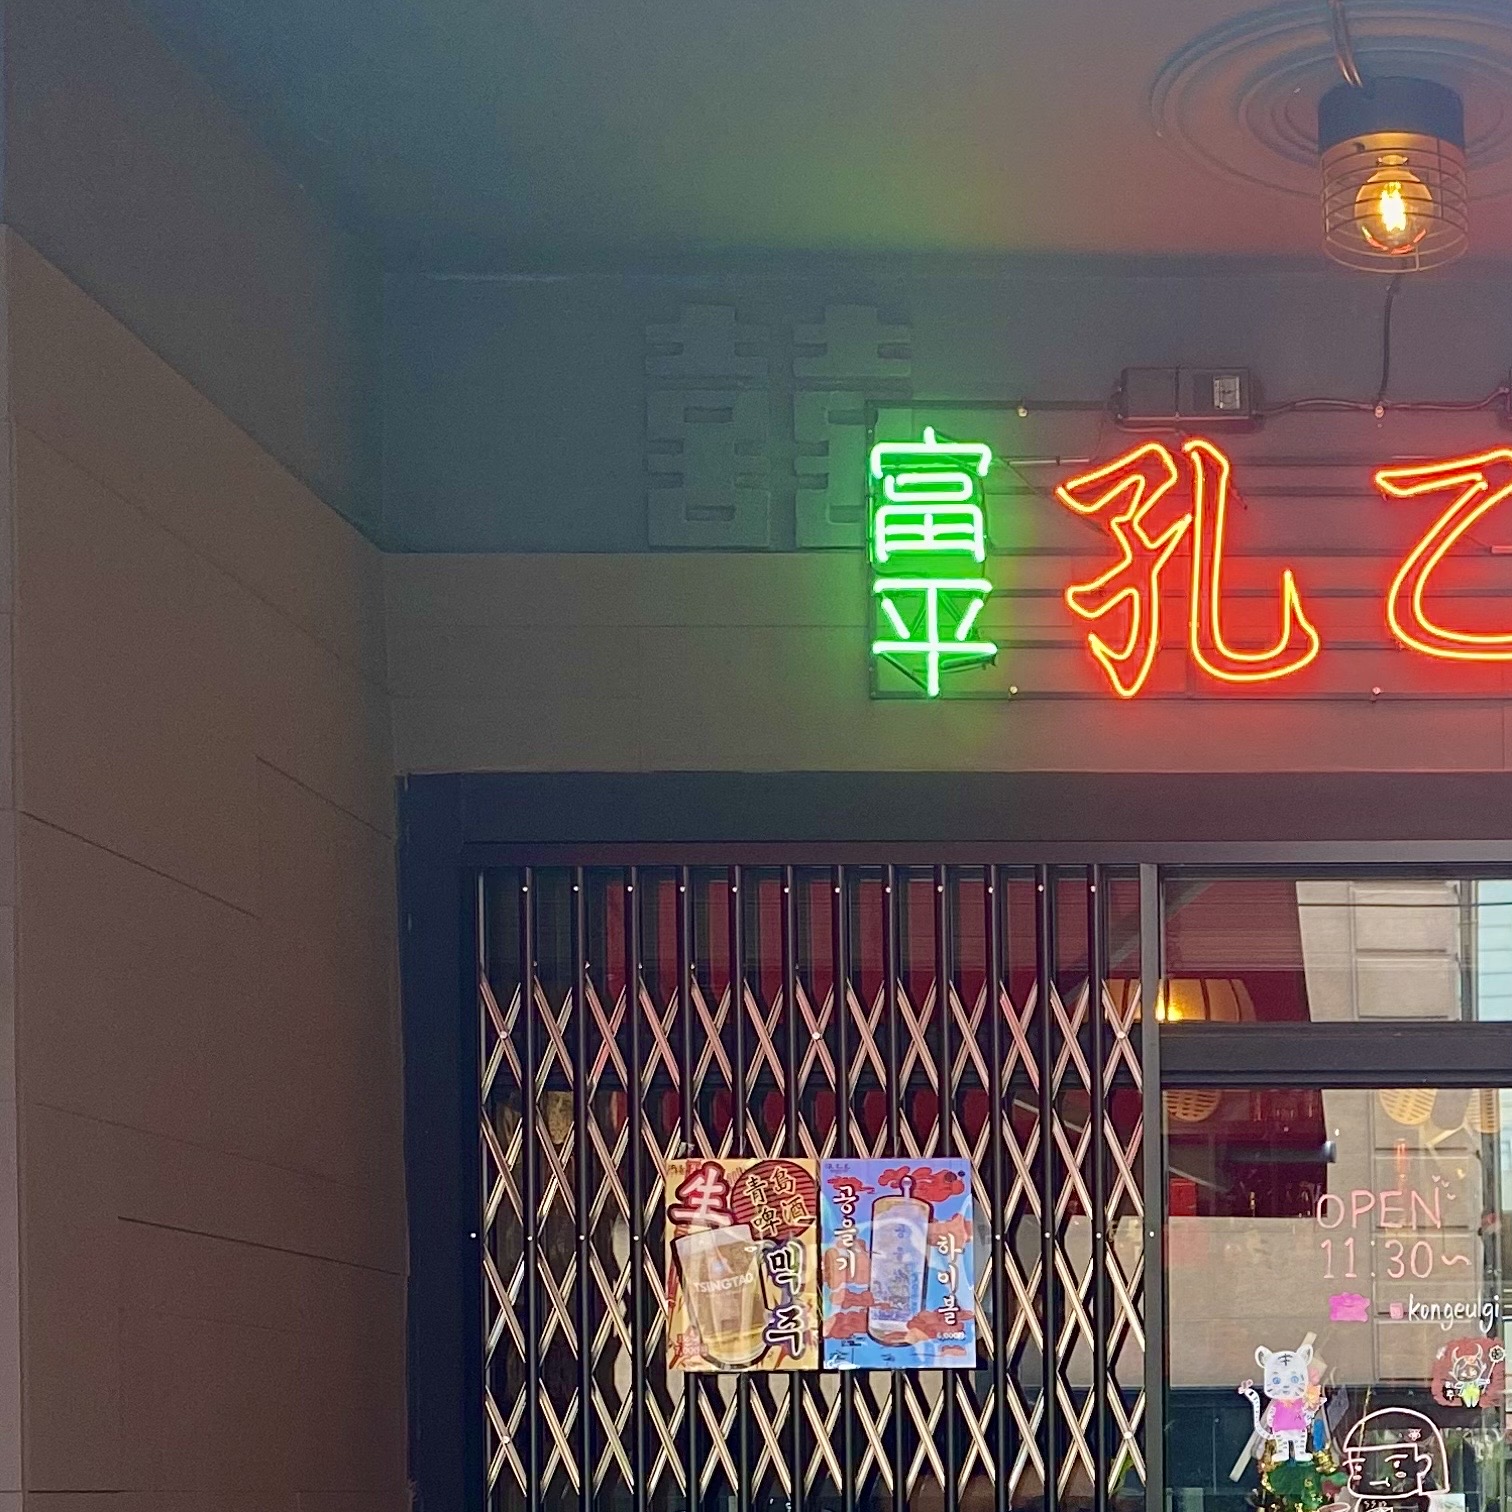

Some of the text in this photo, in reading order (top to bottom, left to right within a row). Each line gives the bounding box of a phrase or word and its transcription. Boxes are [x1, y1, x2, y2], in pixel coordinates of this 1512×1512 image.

[872, 426, 997, 697] 富平
[672, 1166, 735, 1227] 生
[831, 1185, 858, 1279] 공을기
[1316, 1187, 1442, 1231] OPEN
[692, 1271, 755, 1295] TSINGTAO
[936, 1232, 964, 1326] 하이볼
